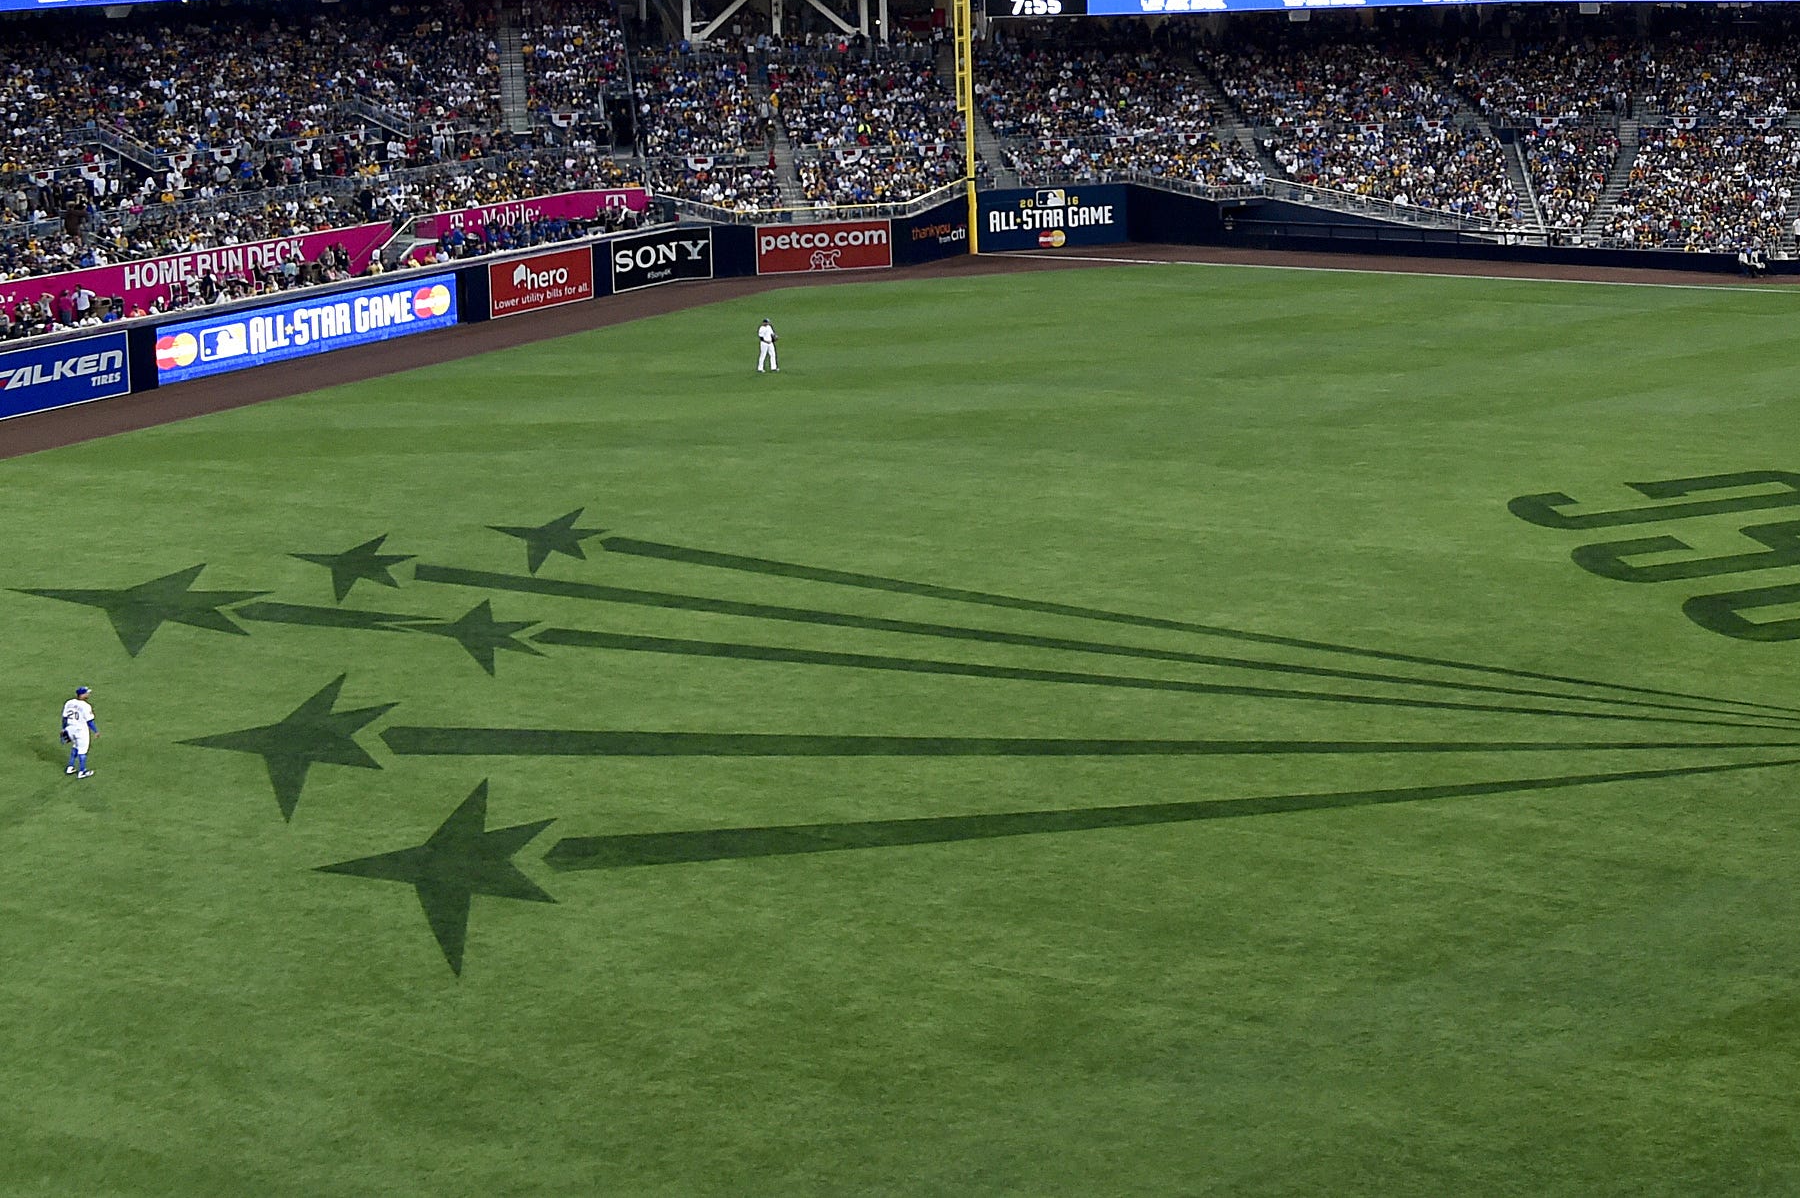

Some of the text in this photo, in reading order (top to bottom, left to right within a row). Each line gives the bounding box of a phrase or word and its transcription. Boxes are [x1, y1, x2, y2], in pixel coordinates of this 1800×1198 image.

[1019, 196, 1079, 209] 20 16
[1067, 205, 1115, 228] GAME
[760, 227, 888, 255] petco.com
[951, 225, 966, 241] citi
[124, 239, 305, 290] HOME RUN DECK
[615, 240, 709, 273] SONY
[526, 267, 569, 290] hero
[494, 282, 590, 310] Lower utility bills for all.
[354, 290, 415, 334] GAME
[91, 371, 122, 387] TIRES
[66, 709, 80, 721] 20
